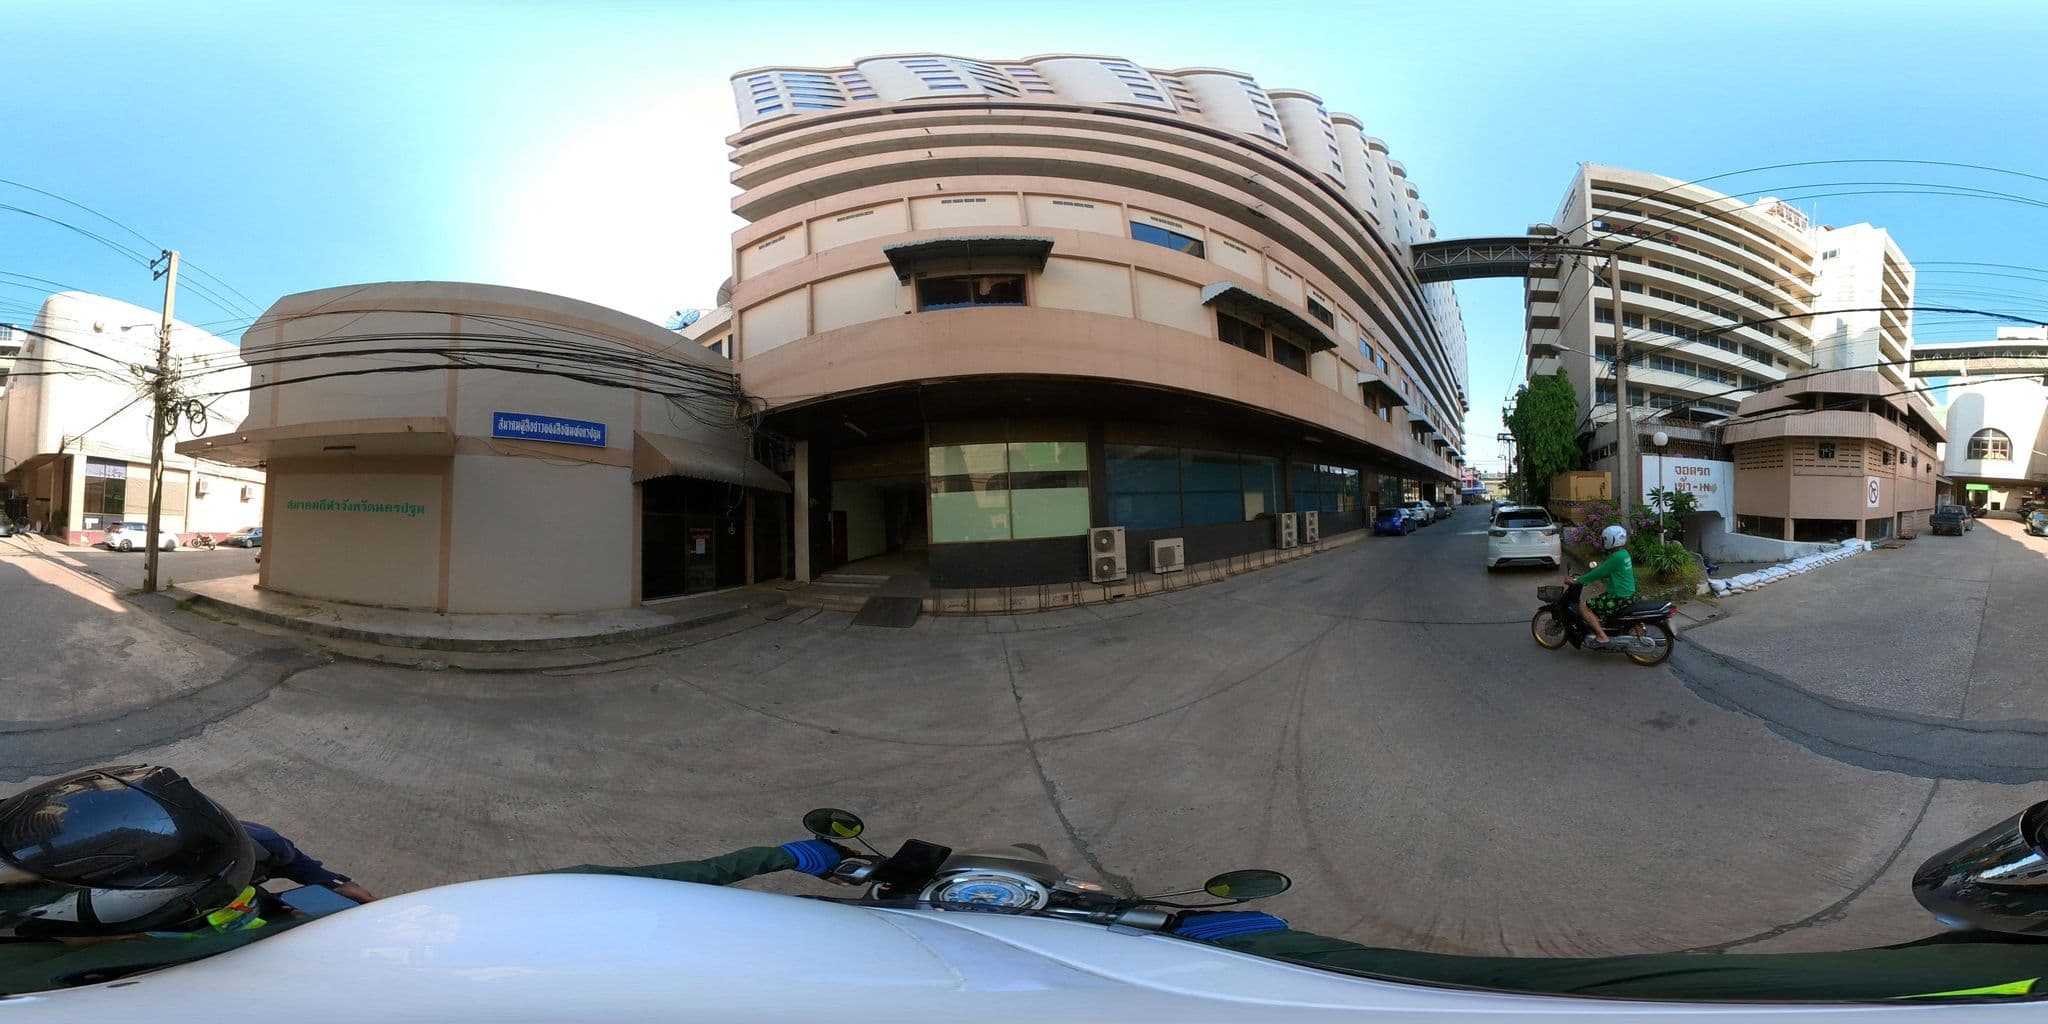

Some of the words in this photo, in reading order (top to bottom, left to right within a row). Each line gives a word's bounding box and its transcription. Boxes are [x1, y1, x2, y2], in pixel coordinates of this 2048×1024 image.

[1675, 466, 1711, 476] จอดรถ
[287, 499, 425, 517] สมาคมกีฬาจังหวัดนครปฐม
